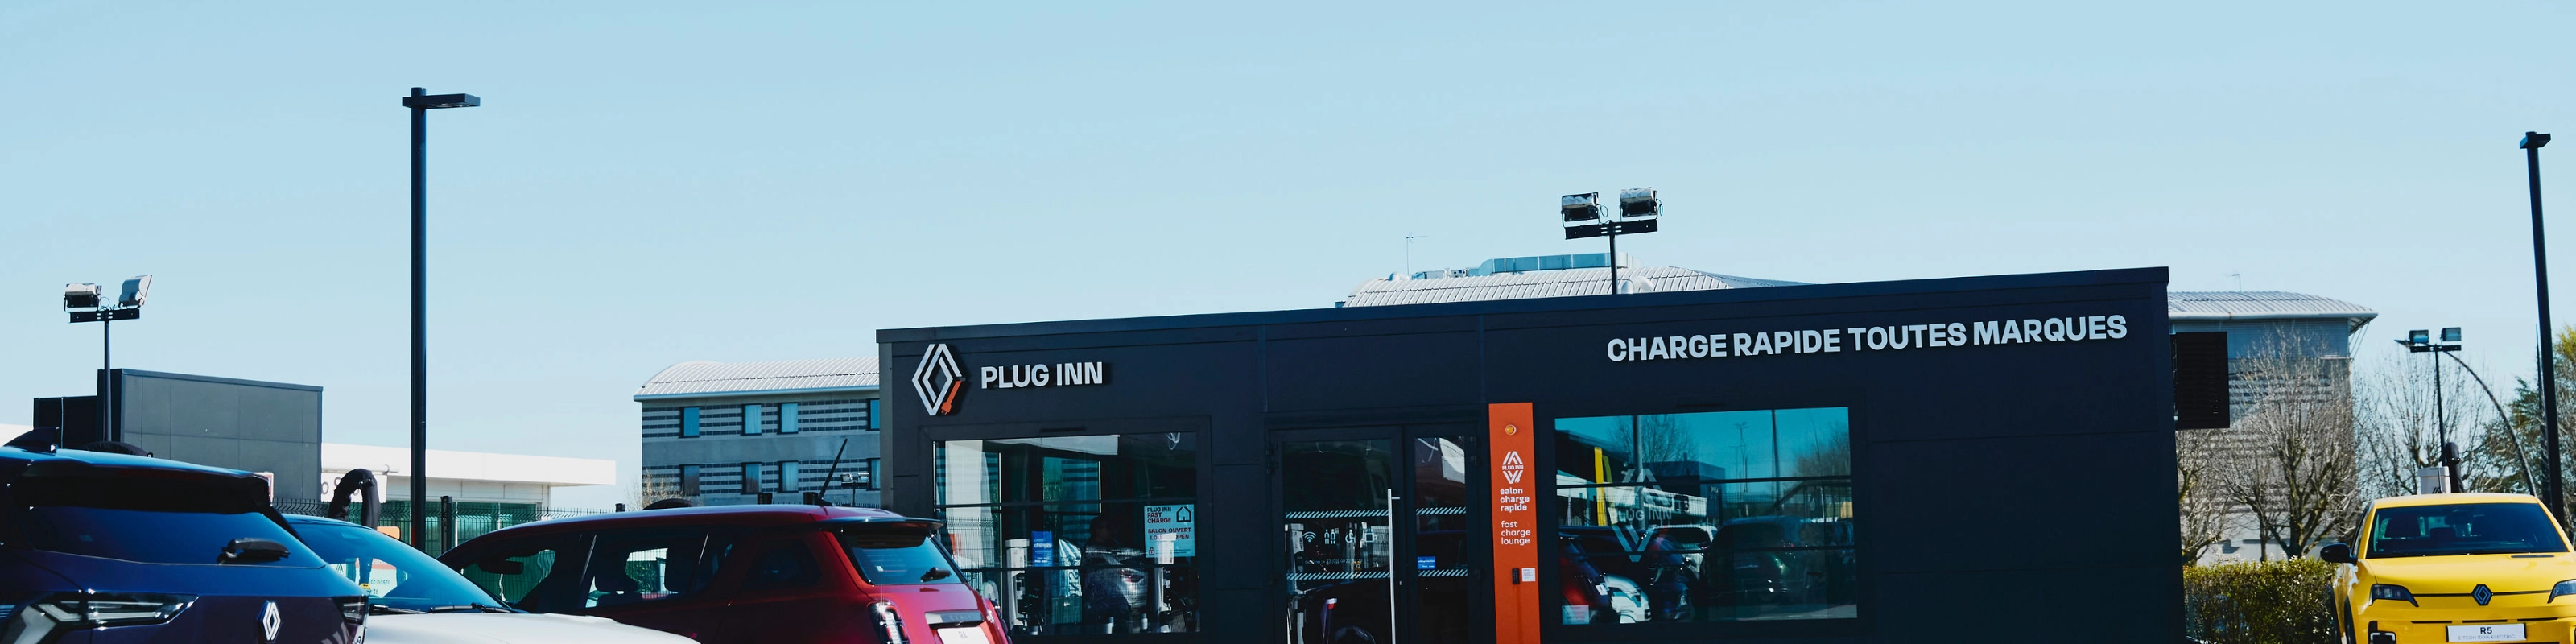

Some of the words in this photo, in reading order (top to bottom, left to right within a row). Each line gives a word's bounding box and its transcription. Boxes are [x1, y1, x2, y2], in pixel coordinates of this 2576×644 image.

[1607, 333, 1728, 362] CHARGE
[1733, 328, 1841, 357] RAPIDE
[1847, 322, 1967, 351] TOUTES
[1973, 314, 2128, 345] MARQUES
[981, 364, 1050, 390] PLUG
[1056, 361, 1103, 386] INN
[1500, 486, 1523, 495] salon
[1500, 495, 1530, 504] charge
[1500, 503, 1528, 513] rapide
[1501, 520, 1517, 528] fast
[1501, 528, 1531, 538] charge
[1501, 537, 1531, 546] lounge
